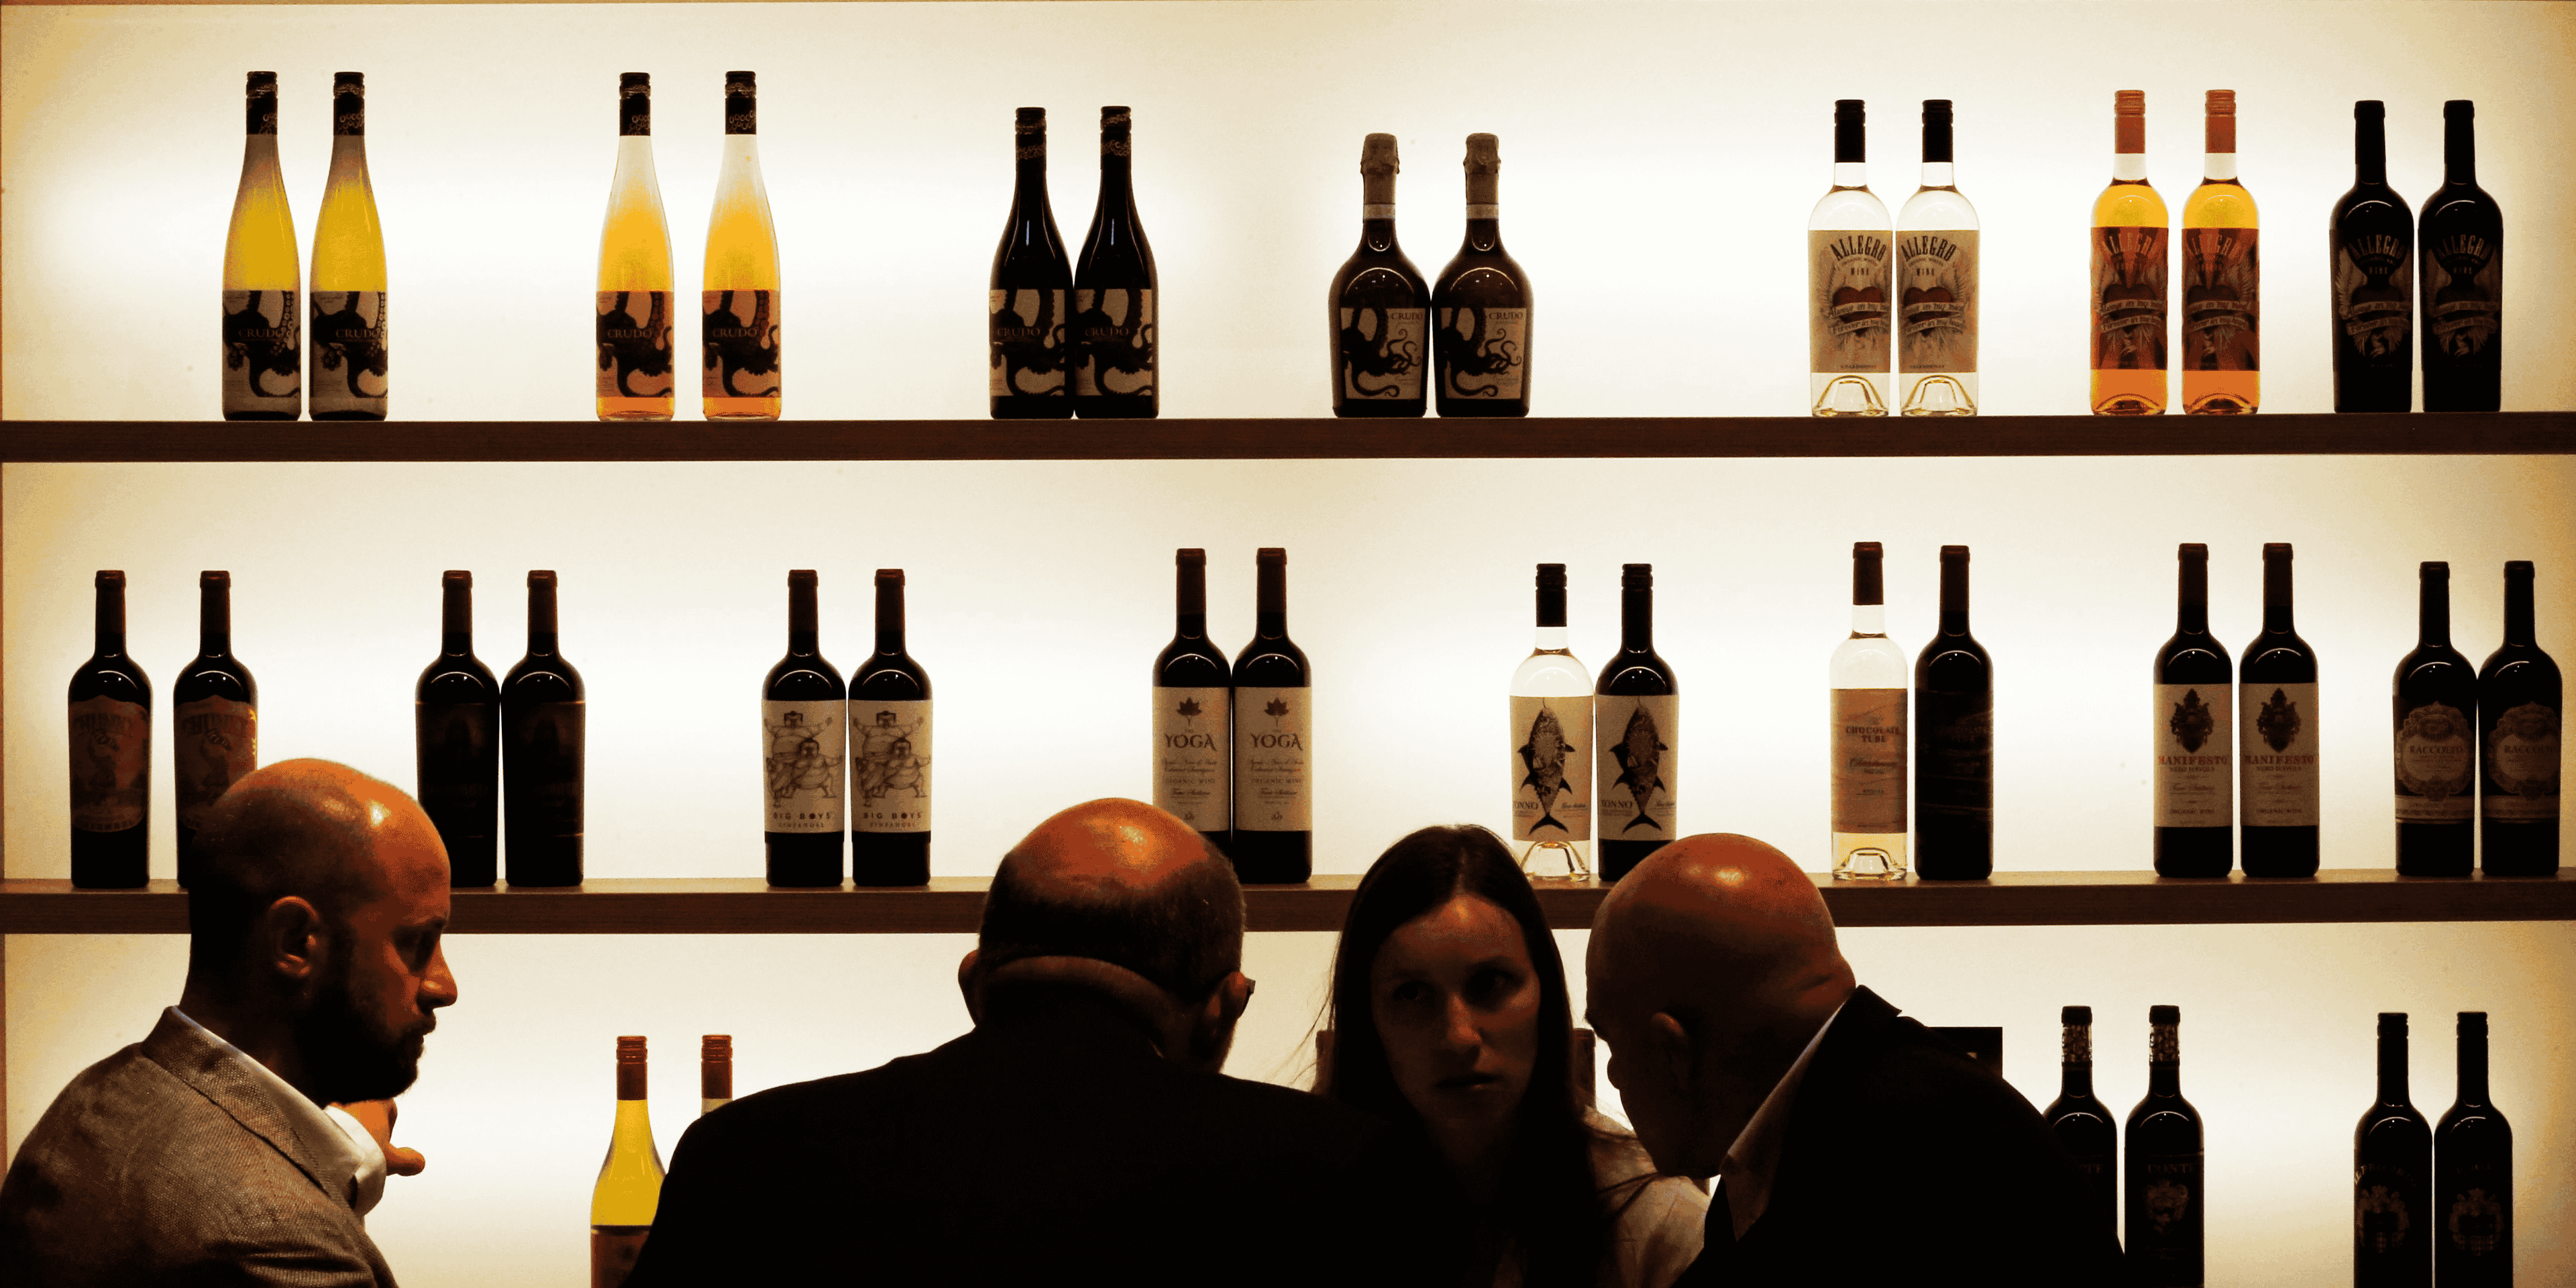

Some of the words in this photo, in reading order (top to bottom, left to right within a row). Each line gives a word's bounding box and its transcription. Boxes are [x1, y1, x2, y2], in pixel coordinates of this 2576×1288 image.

[1830, 235, 1887, 262] ALLEGRO
[1900, 235, 1957, 262] ALLEGRO
[2349, 233, 2406, 260] ALLEGRO
[2435, 233, 2492, 260] ALLEGRO
[1391, 312, 1424, 320] CRUDO
[1489, 312, 1523, 320] CRUDO
[238, 328, 284, 339] CRUDO
[335, 328, 380, 339] CRUDO
[607, 329, 653, 338] CRUDO
[712, 328, 758, 338] CRUDO
[997, 327, 1041, 337] CRUDO
[1085, 327, 1130, 337] CRUDO
[1164, 733, 1218, 751] YOGA
[1250, 733, 1303, 751] YOGA
[2410, 745, 2463, 754] RACCOLTO
[2158, 755, 2228, 765] MANIFESTO
[2244, 755, 2314, 765] MANIFESTO
[773, 812, 792, 820] BIG
[799, 812, 830, 820] BOYS
[892, 812, 921, 820] BOYS
